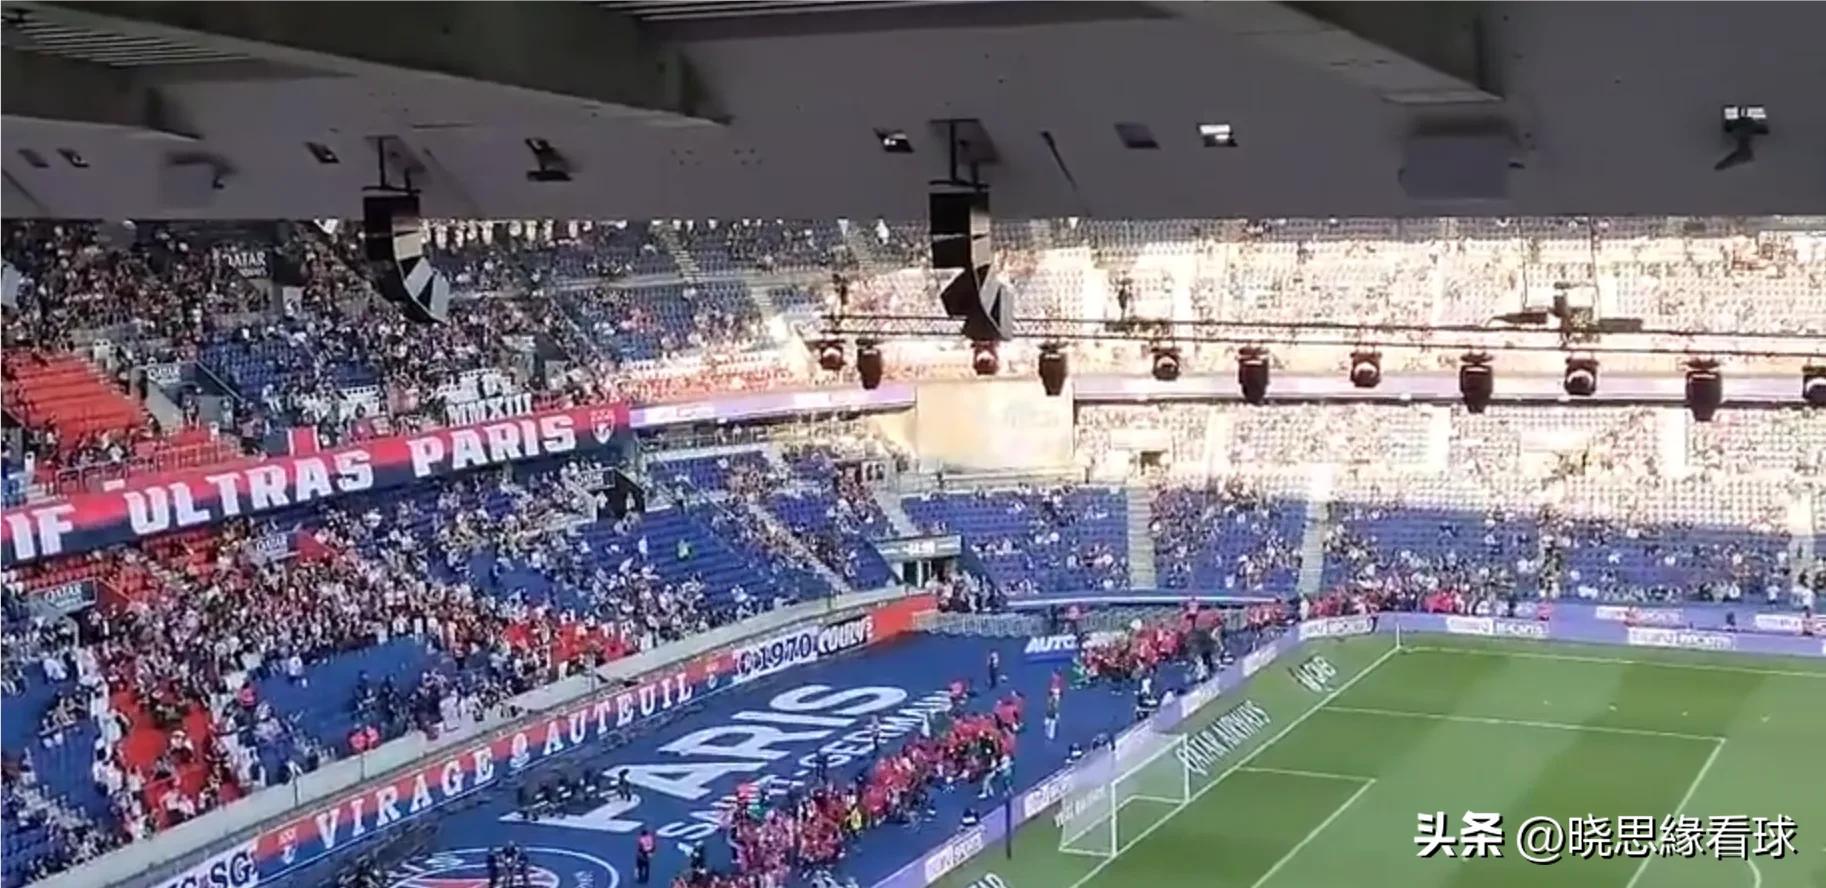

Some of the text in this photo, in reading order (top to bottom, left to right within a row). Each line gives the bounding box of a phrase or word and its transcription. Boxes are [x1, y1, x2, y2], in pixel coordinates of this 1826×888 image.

[123, 450, 374, 535] ULTRAS
[406, 414, 577, 478] PARIS
[315, 672, 692, 851] VIRAGE AUTEUIL
[498, 684, 908, 832] PARIS
[1176, 699, 1271, 776] QATAR AIRWAYS
